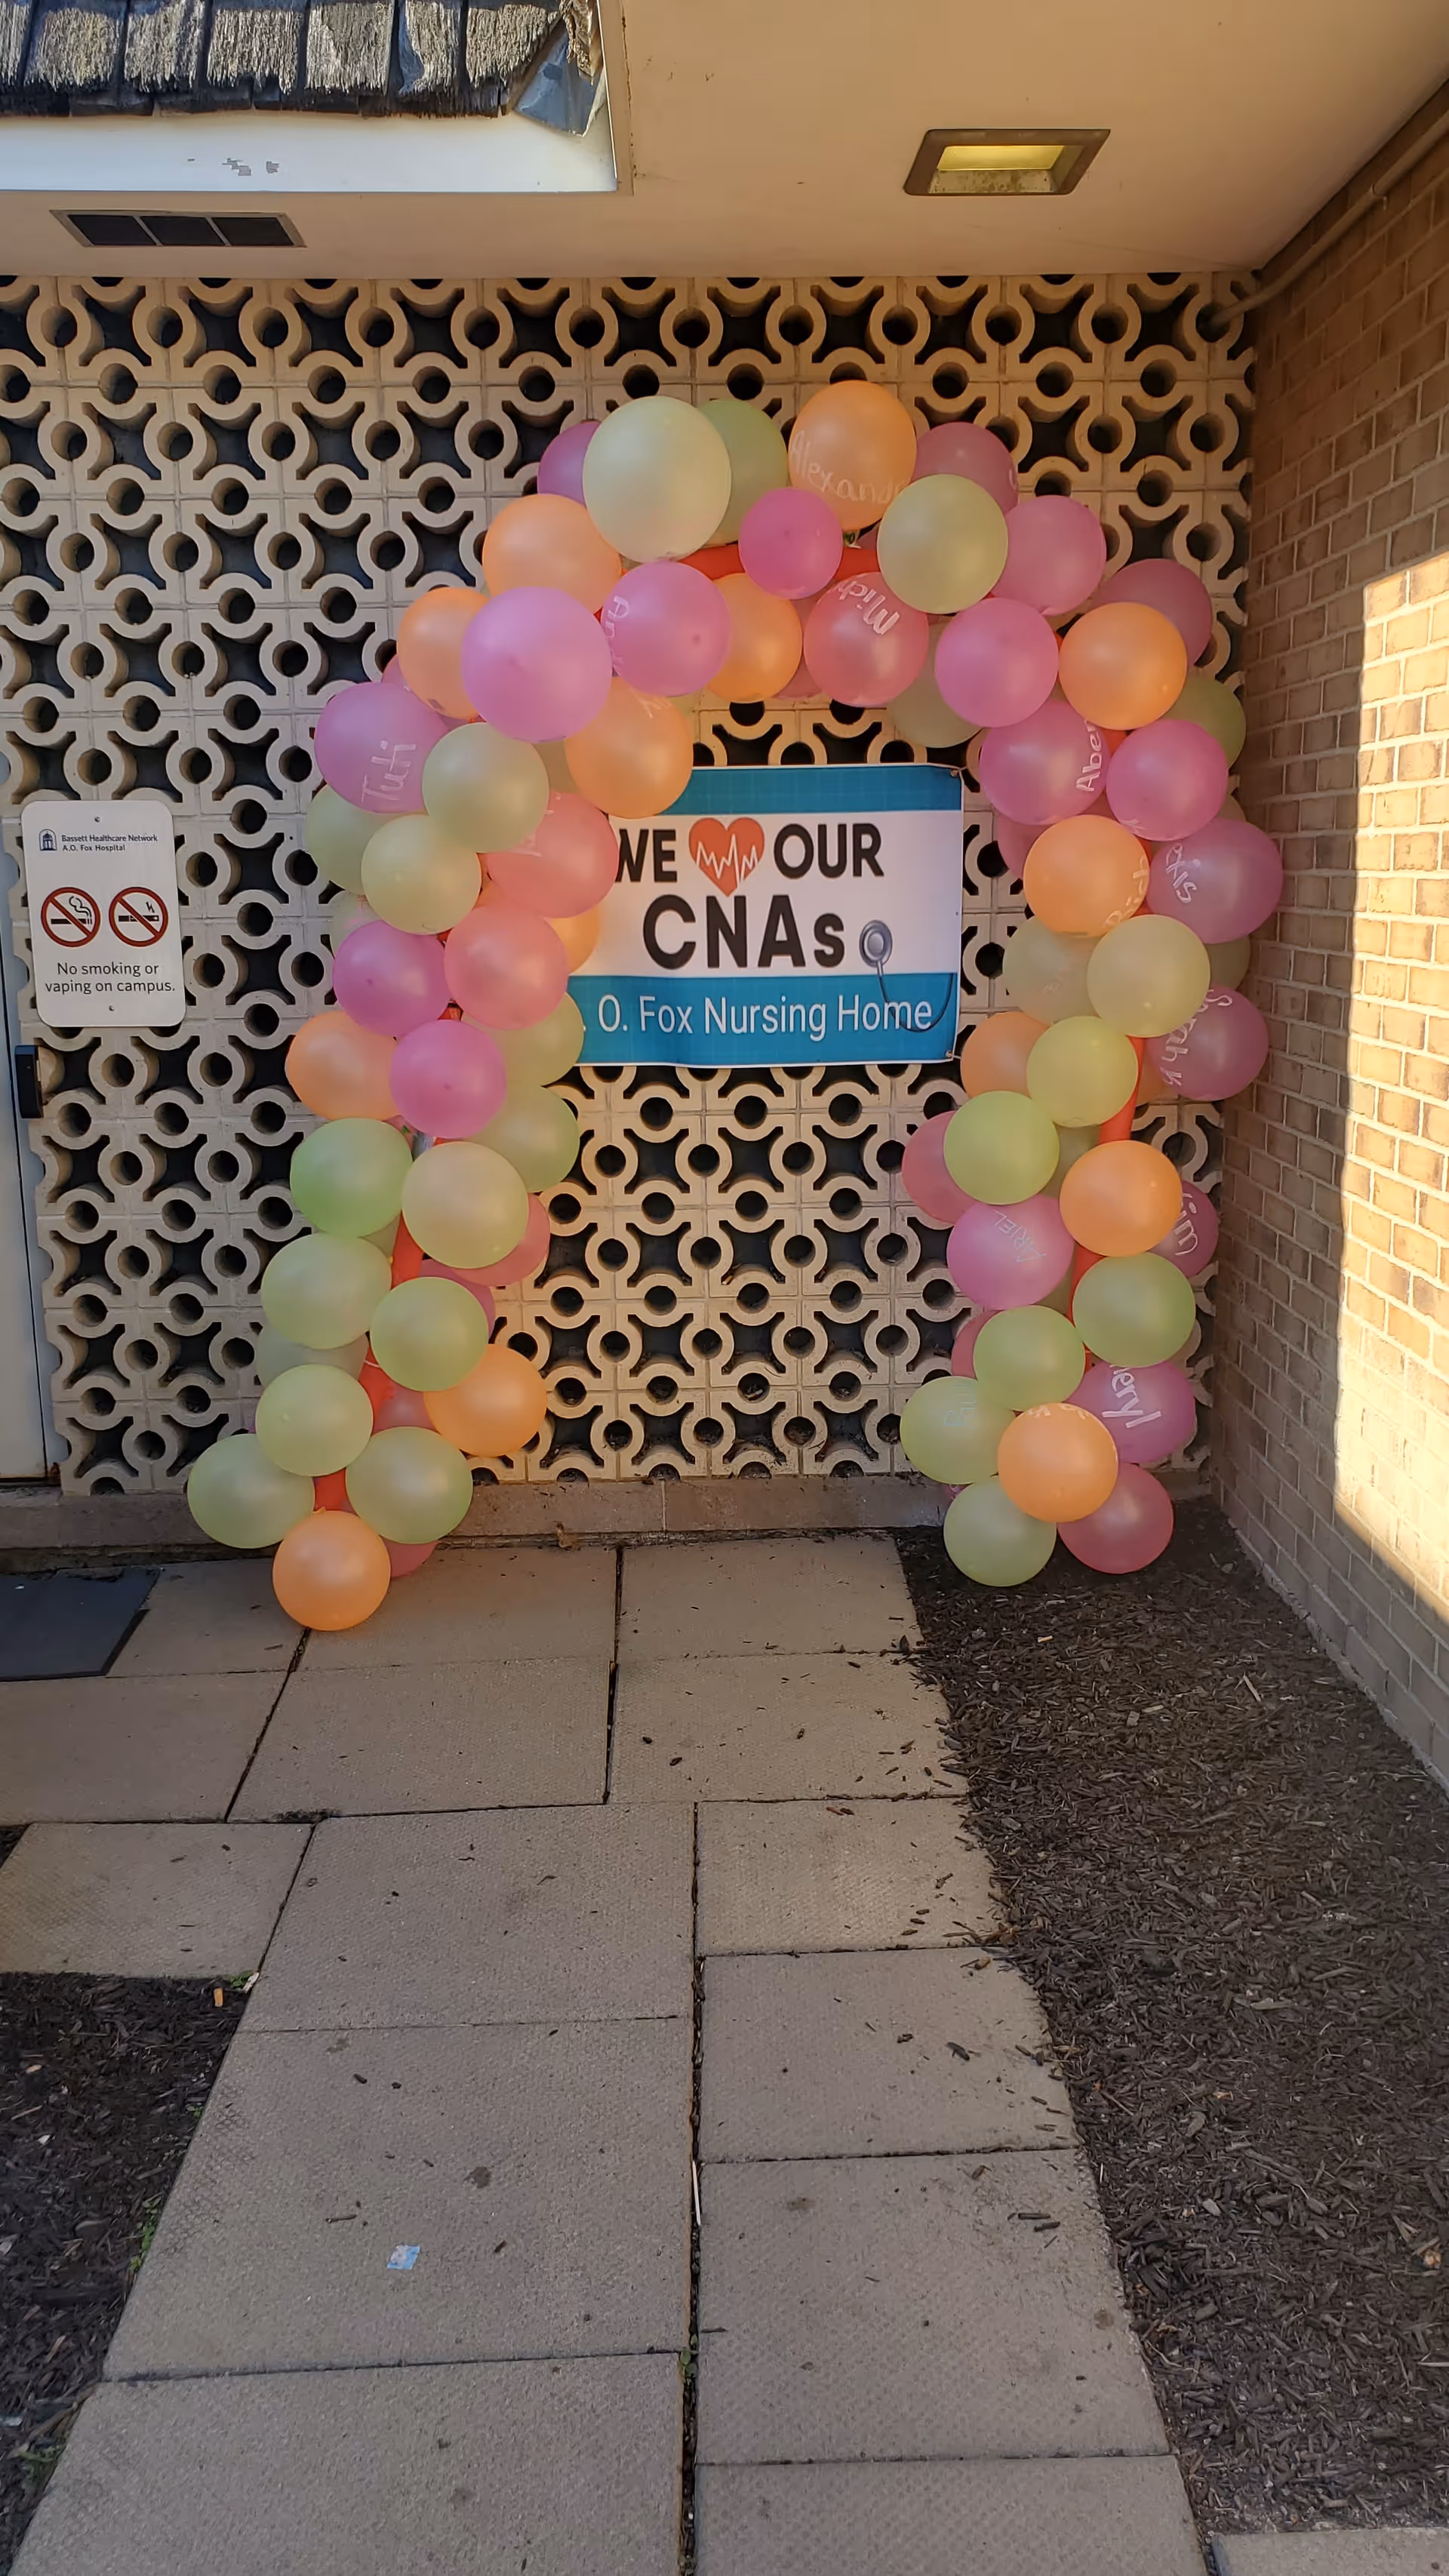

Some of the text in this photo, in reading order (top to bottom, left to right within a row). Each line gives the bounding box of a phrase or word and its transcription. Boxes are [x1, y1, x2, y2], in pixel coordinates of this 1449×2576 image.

[89, 834, 127, 842] Healthcare
[128, 834, 158, 842] Network
[95, 844, 126, 853] Hospital
[614, 823, 884, 883] WE OUR
[642, 894, 845, 970] CNAs
[57, 962, 159, 977] No smoking or
[45, 980, 176, 995] vaping on campus.
[598, 994, 933, 1042] O. Fox Nursing Home
